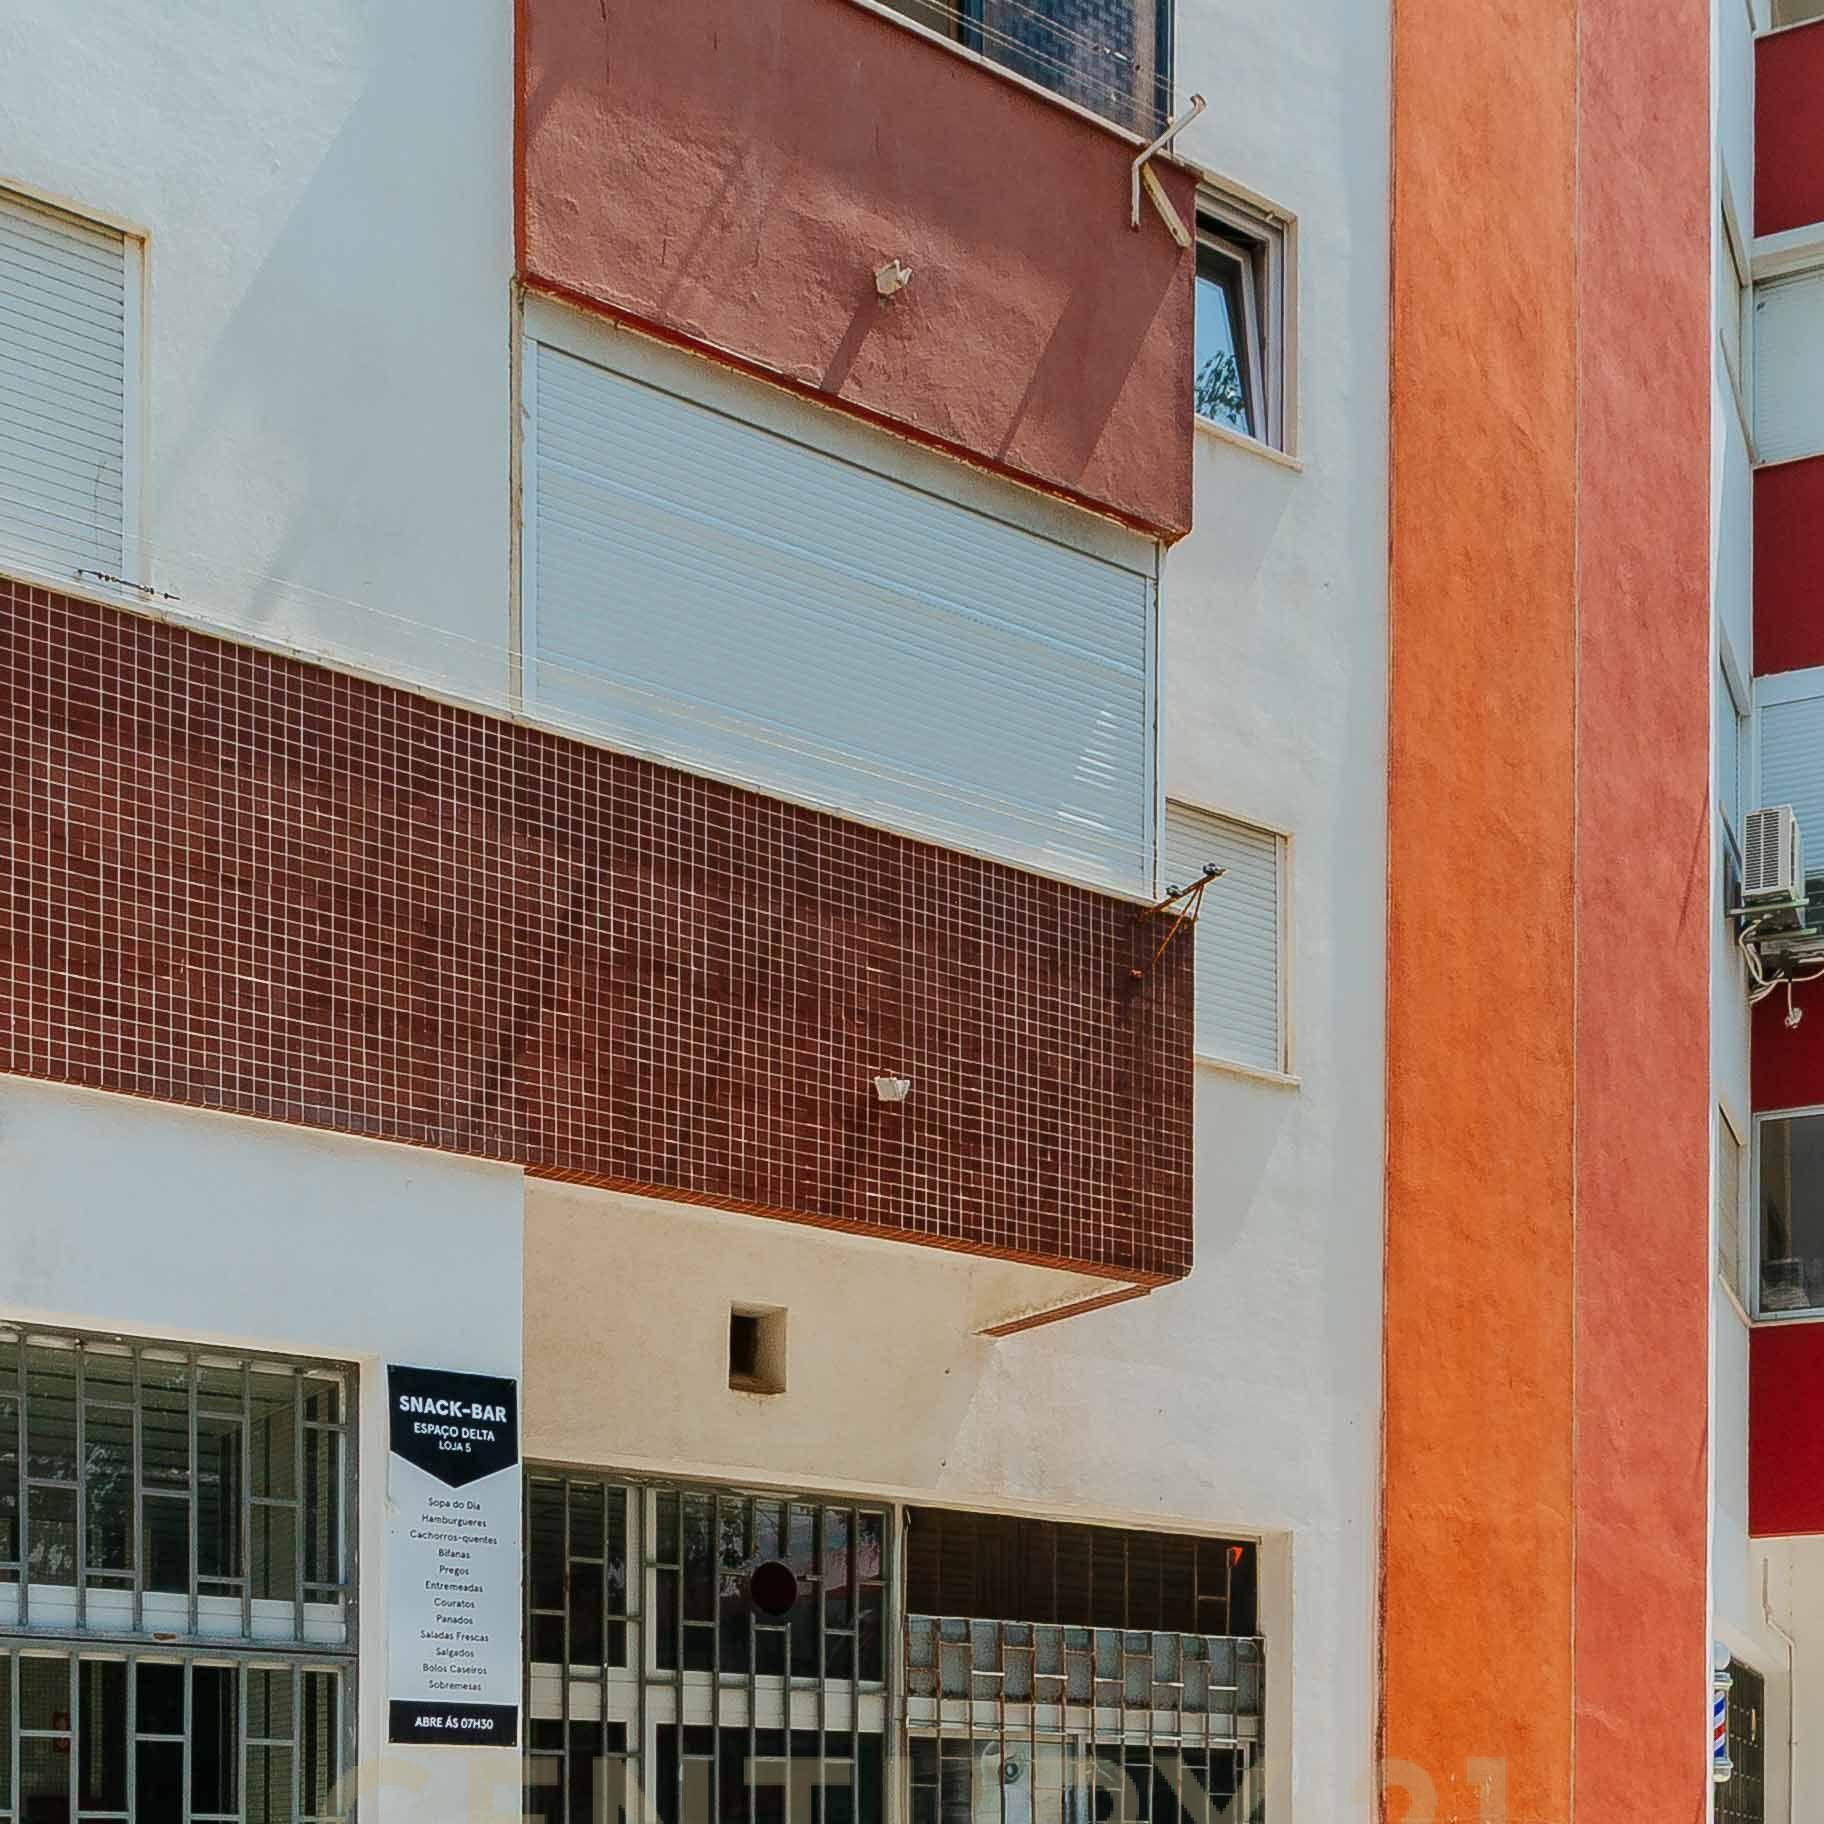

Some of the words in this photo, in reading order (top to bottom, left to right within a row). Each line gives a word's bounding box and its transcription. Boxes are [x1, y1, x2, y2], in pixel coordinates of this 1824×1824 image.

[399, 1395, 508, 1423] SNACK-BAR
[413, 1422, 459, 1439] ESPAÇO
[462, 1427, 496, 1442] DELTA
[438, 1440, 464, 1452] LOJA
[465, 1443, 472, 1453] 5
[428, 1497, 451, 1509] Sopa
[452, 1500, 465, 1509] do
[467, 1501, 481, 1511] Dia
[422, 1513, 487, 1528] Hamburgueres
[409, 1529, 498, 1545] Cachorros-quentes
[438, 1548, 471, 1559] Bifanas
[439, 1565, 470, 1577] Pregos
[425, 1580, 484, 1593] Entremeadas
[433, 1597, 475, 1609] Couratos
[436, 1614, 474, 1625] Panados
[420, 1630, 454, 1640] Saladas
[456, 1632, 489, 1642] Frescas
[435, 1647, 475, 1659] Salgados
[422, 1663, 447, 1673] Bolos
[449, 1664, 488, 1675] Caseiros
[428, 1680, 482, 1691] Sobremesas
[414, 1716, 444, 1728] ABRE
[445, 1714, 459, 1729] ÁS
[461, 1718, 494, 1730] 07H30
